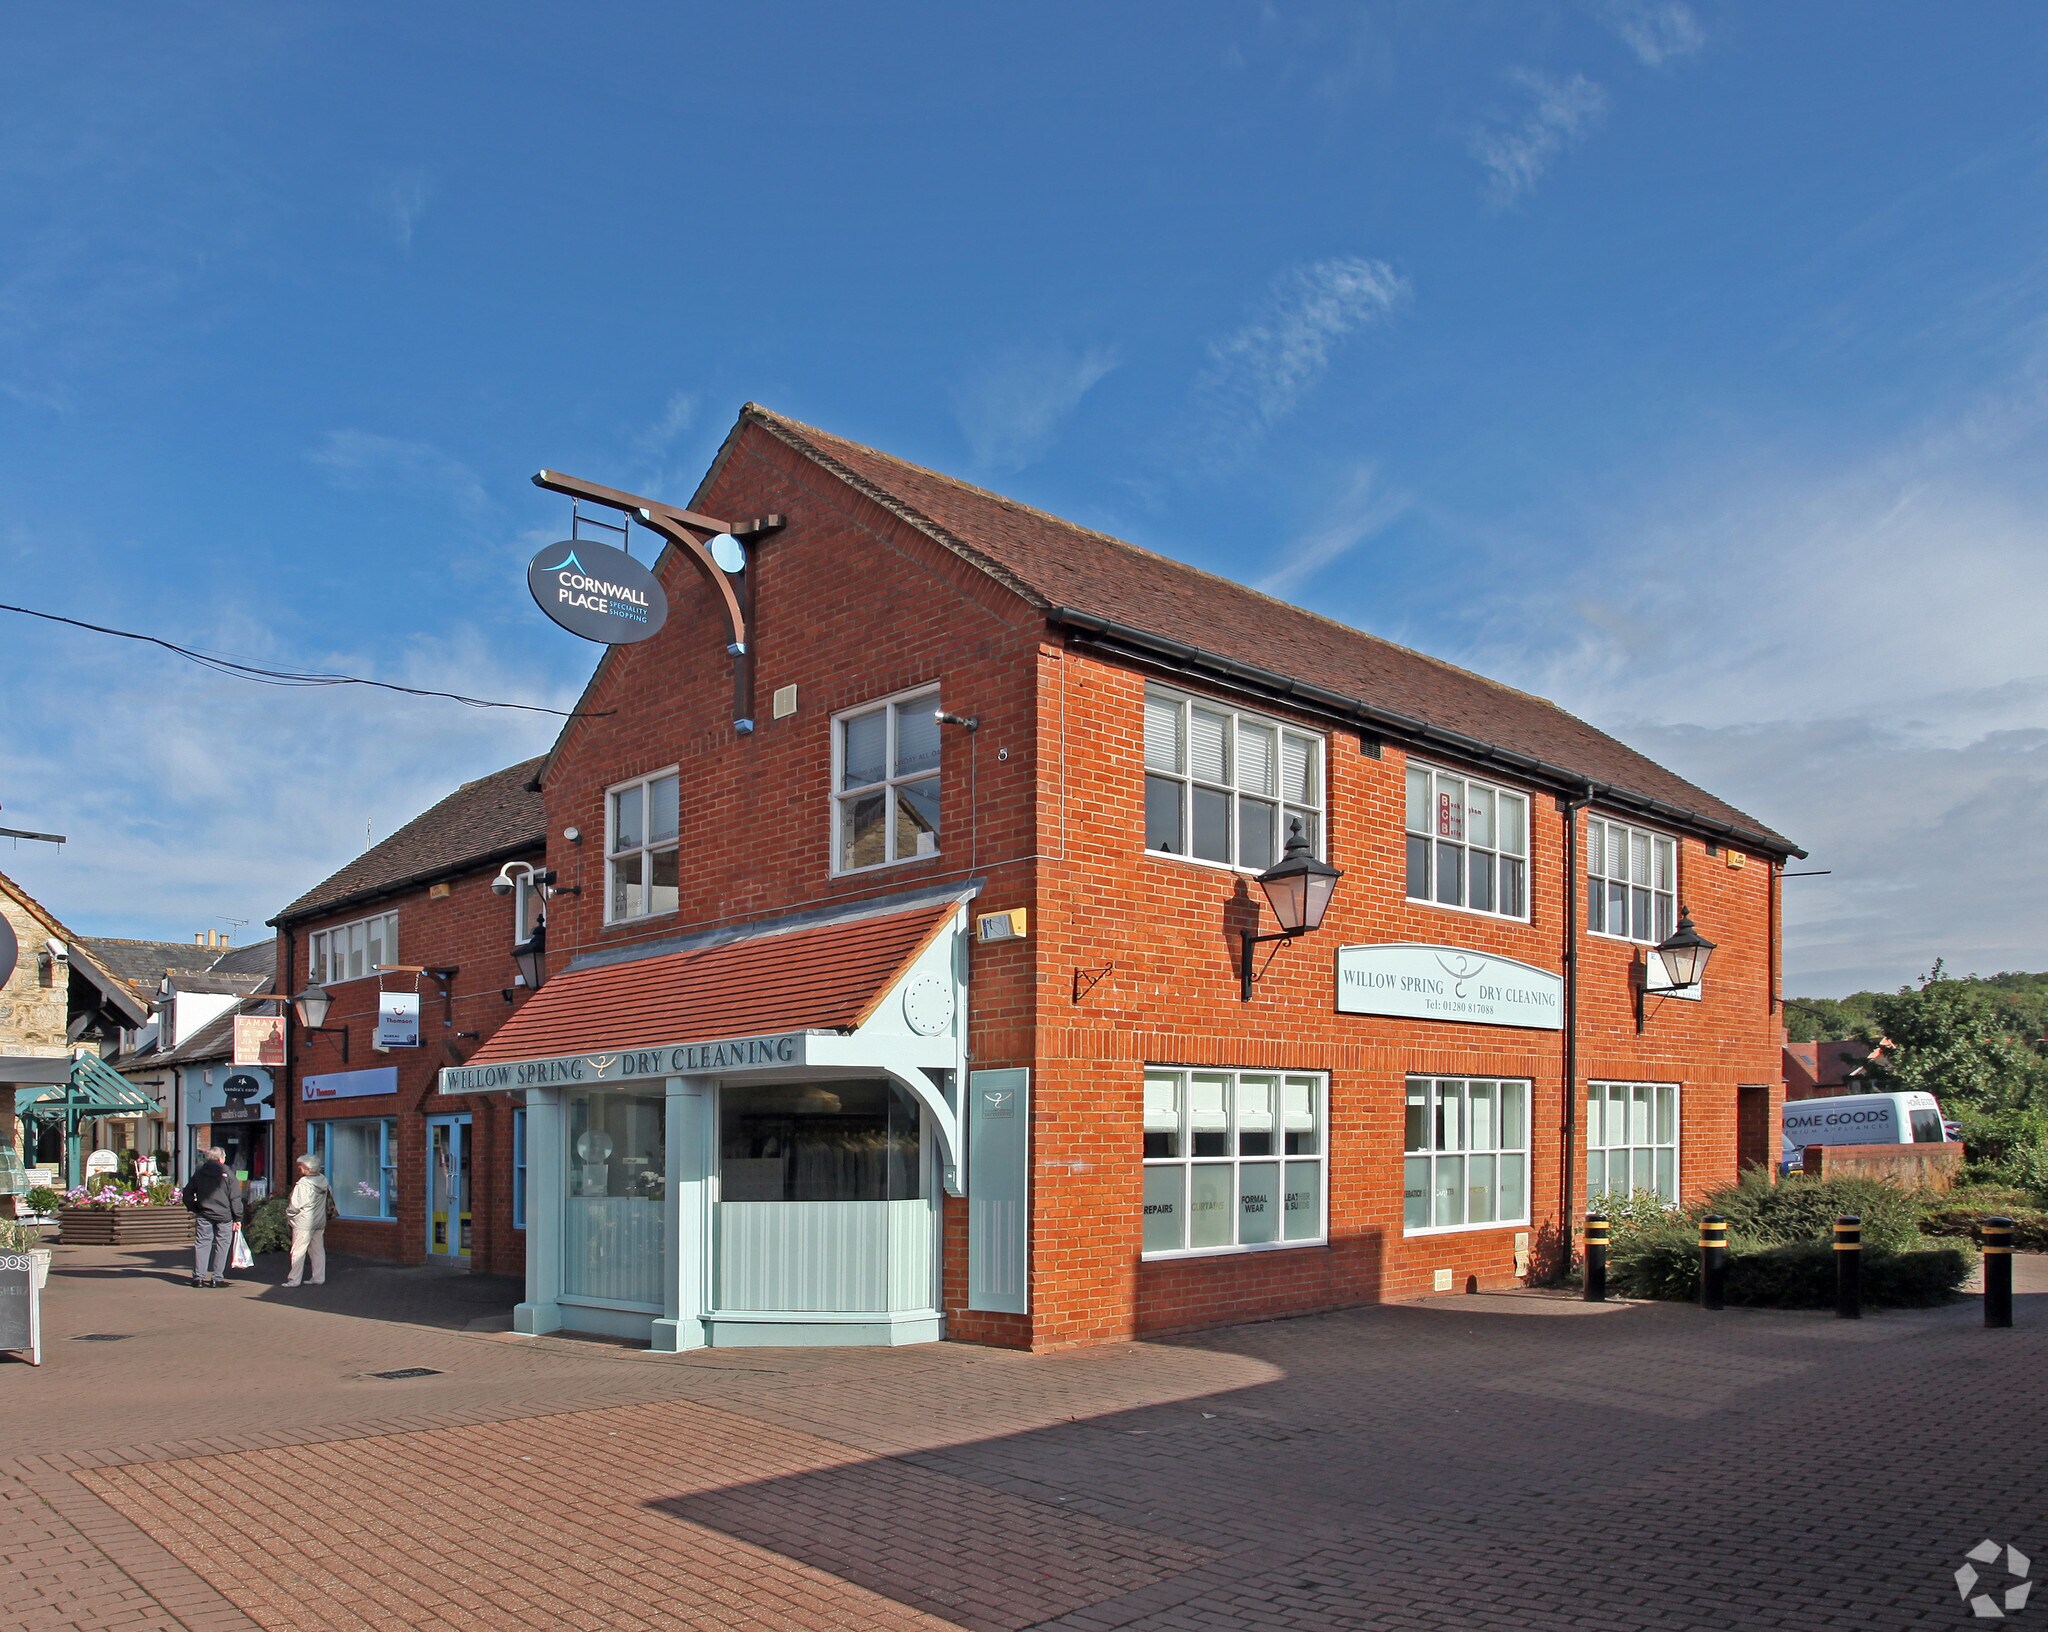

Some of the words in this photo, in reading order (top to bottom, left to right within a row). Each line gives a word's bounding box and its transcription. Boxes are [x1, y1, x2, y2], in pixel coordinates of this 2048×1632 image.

[559, 571, 649, 607] CORNWALL
[559, 588, 608, 613] PLACE
[609, 600, 648, 615] SPECIALITY
[609, 608, 648, 624] SHOPPING
[1343, 969, 1397, 990] WILLOW
[1400, 976, 1444, 995] SPRING
[1479, 985, 1502, 1001] DRY
[1505, 988, 1556, 1007] CLEANING
[1425, 998, 1441, 1010] Tel:
[1443, 1001, 1466, 1013] 01280
[1468, 1003, 1494, 1015] 817088
[447, 1065, 512, 1090] WILLOW
[518, 1059, 584, 1085] SPRING
[622, 1050, 663, 1075] DRY
[671, 1037, 793, 1071] CLEANING
[1826, 1109, 1888, 1125] GOODS
[1242, 1194, 1267, 1205] FORMAL
[1284, 1192, 1310, 1202] LEATHER
[1144, 1204, 1173, 1215] REPAIRS
[1191, 1201, 1224, 1212] CURTAINS
[1245, 1205, 1264, 1213] WEAR
